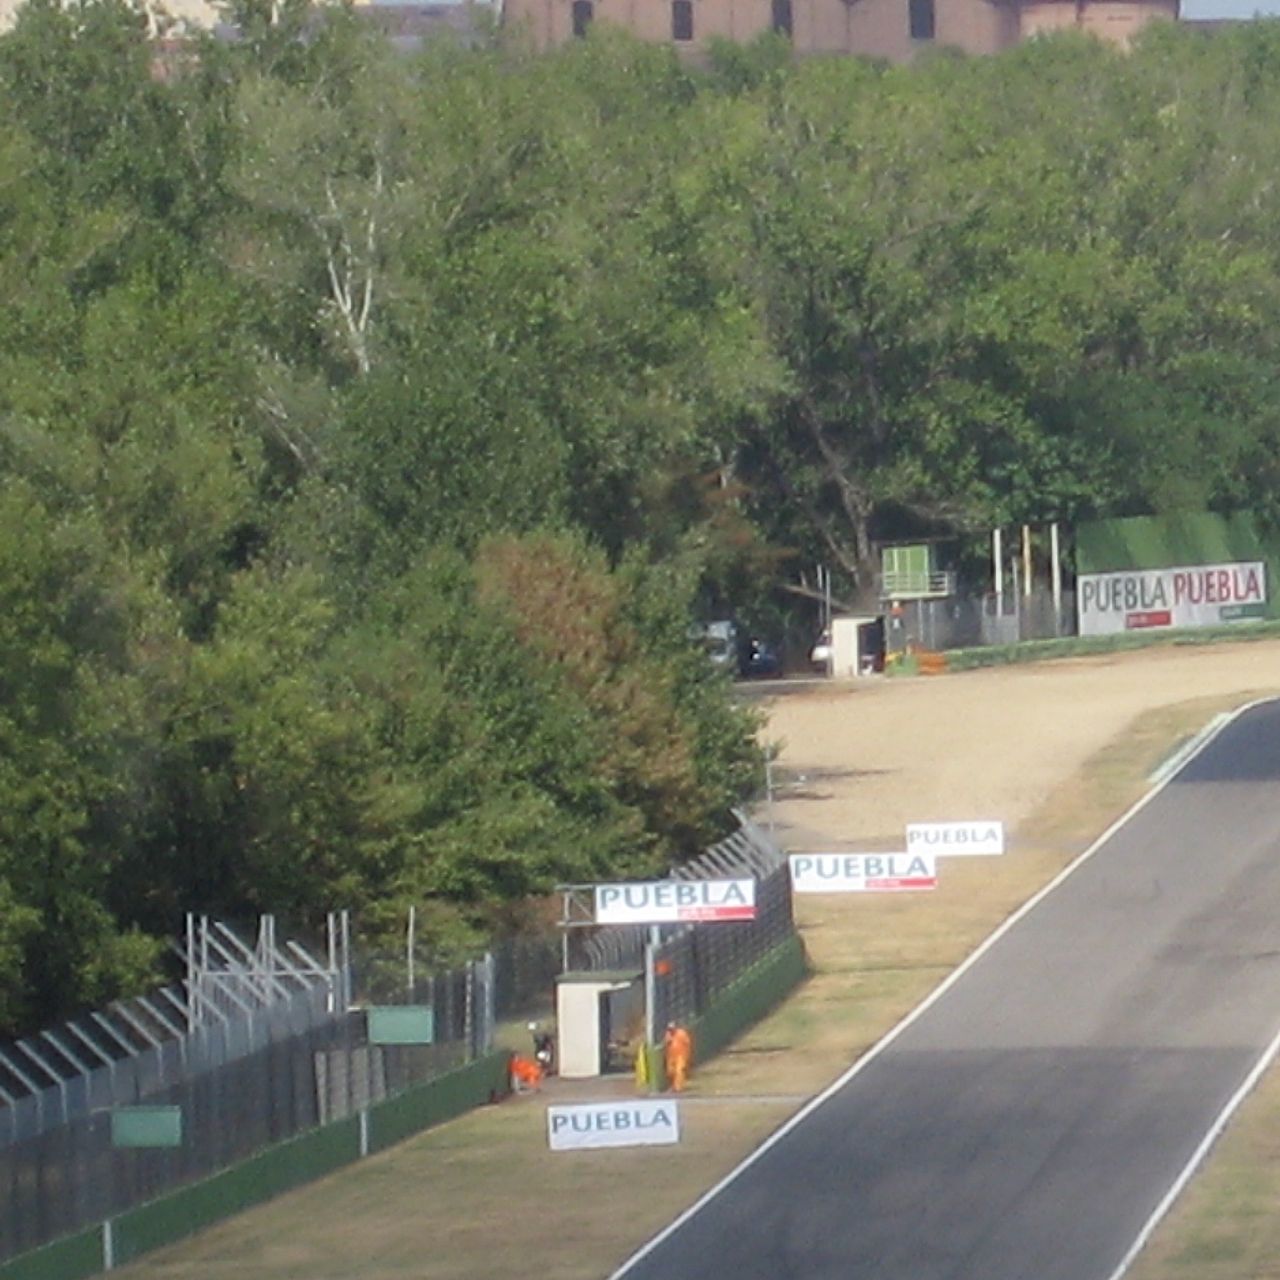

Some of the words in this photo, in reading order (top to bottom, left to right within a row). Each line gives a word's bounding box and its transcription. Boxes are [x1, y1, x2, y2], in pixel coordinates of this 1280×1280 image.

[1082, 576, 1167, 613] PUEBLA
[1174, 569, 1262, 605] PUEBLA
[909, 828, 999, 844] PUEBLA
[795, 856, 930, 879] PUEBLA
[601, 882, 747, 909] PUEBLA
[552, 1109, 671, 1133] PUEBLA
